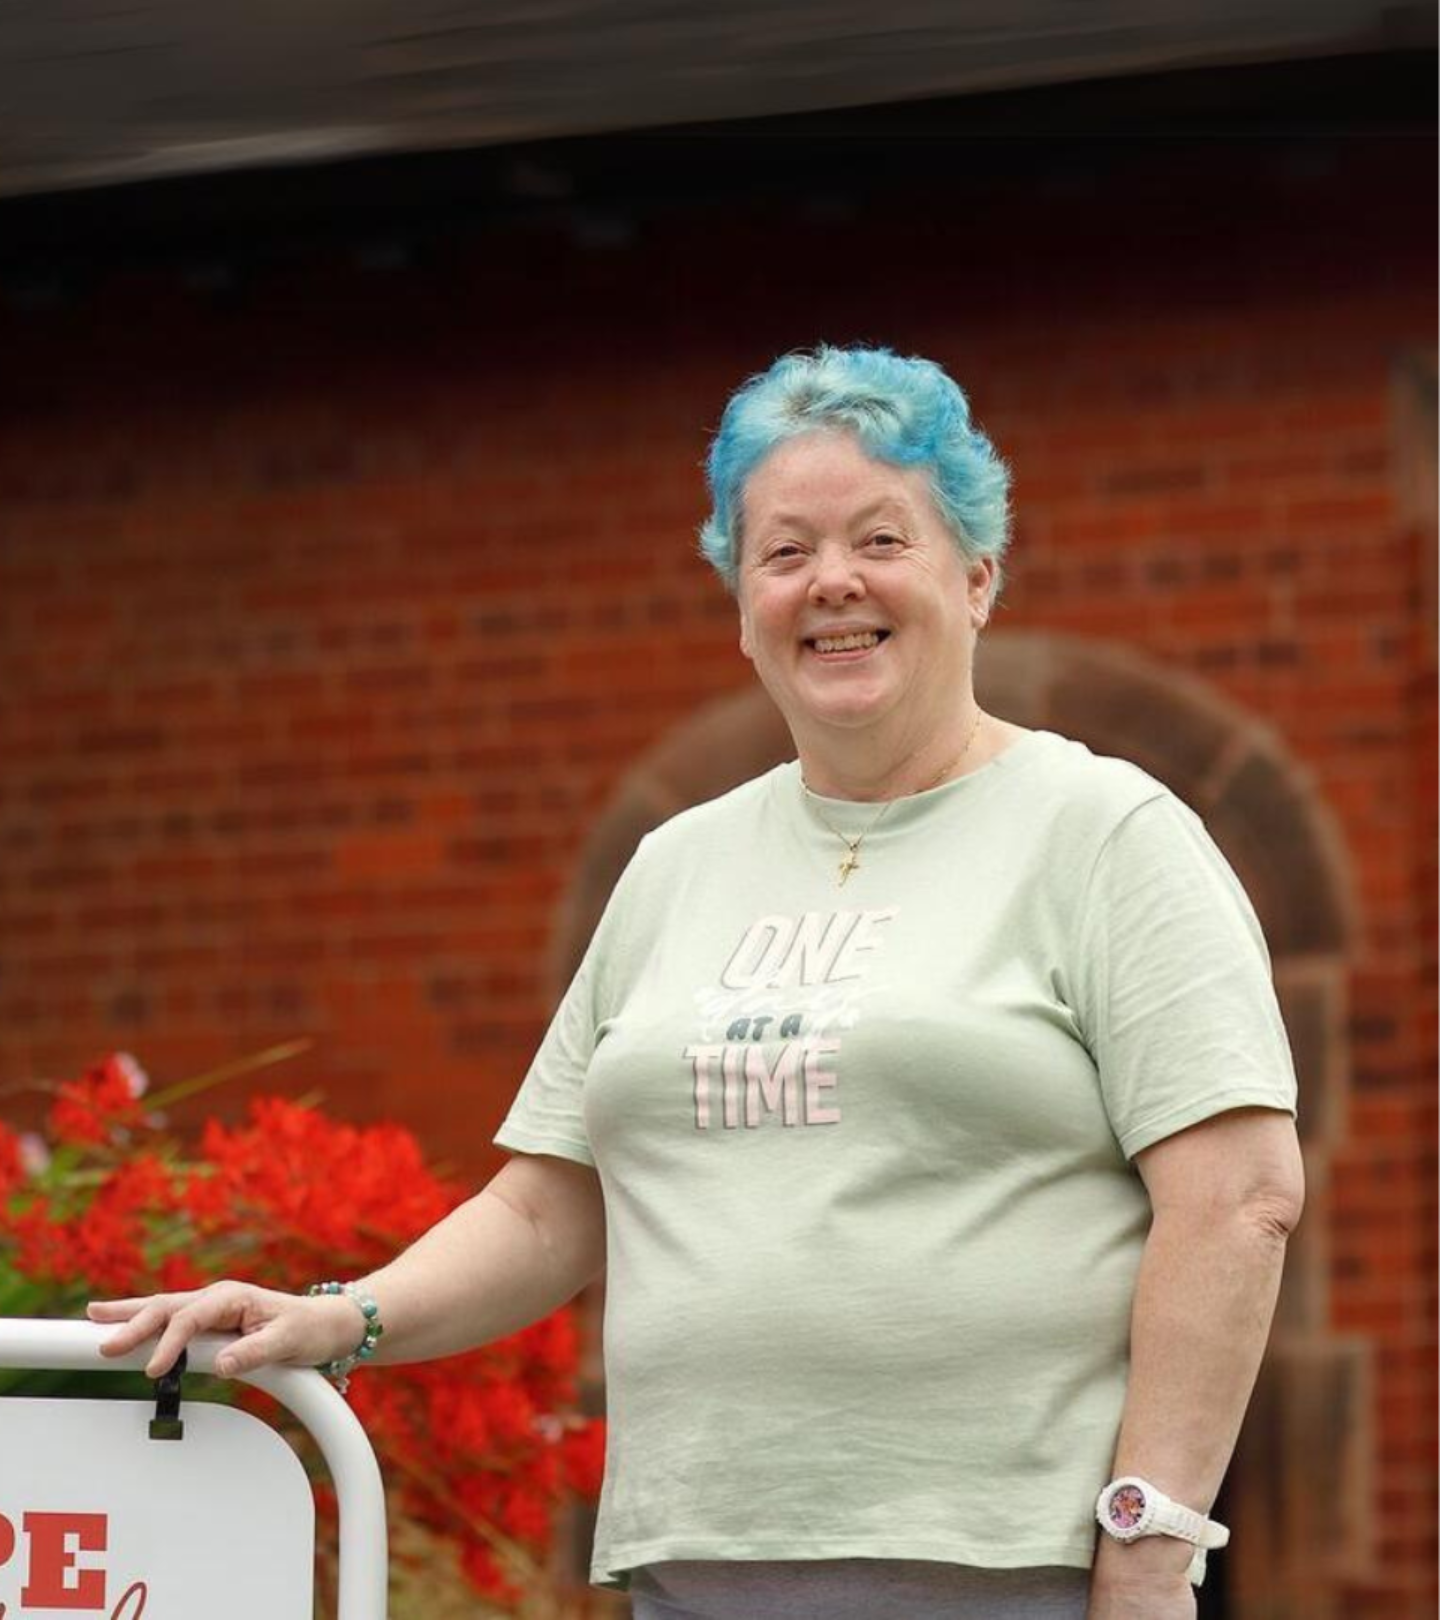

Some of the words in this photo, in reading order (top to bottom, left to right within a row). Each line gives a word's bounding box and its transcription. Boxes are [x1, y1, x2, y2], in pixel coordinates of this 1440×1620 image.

[721, 905, 901, 990] ONE
[726, 1016, 773, 1041] AT
[779, 1013, 804, 1038] A
[683, 1038, 841, 1129] TIME
